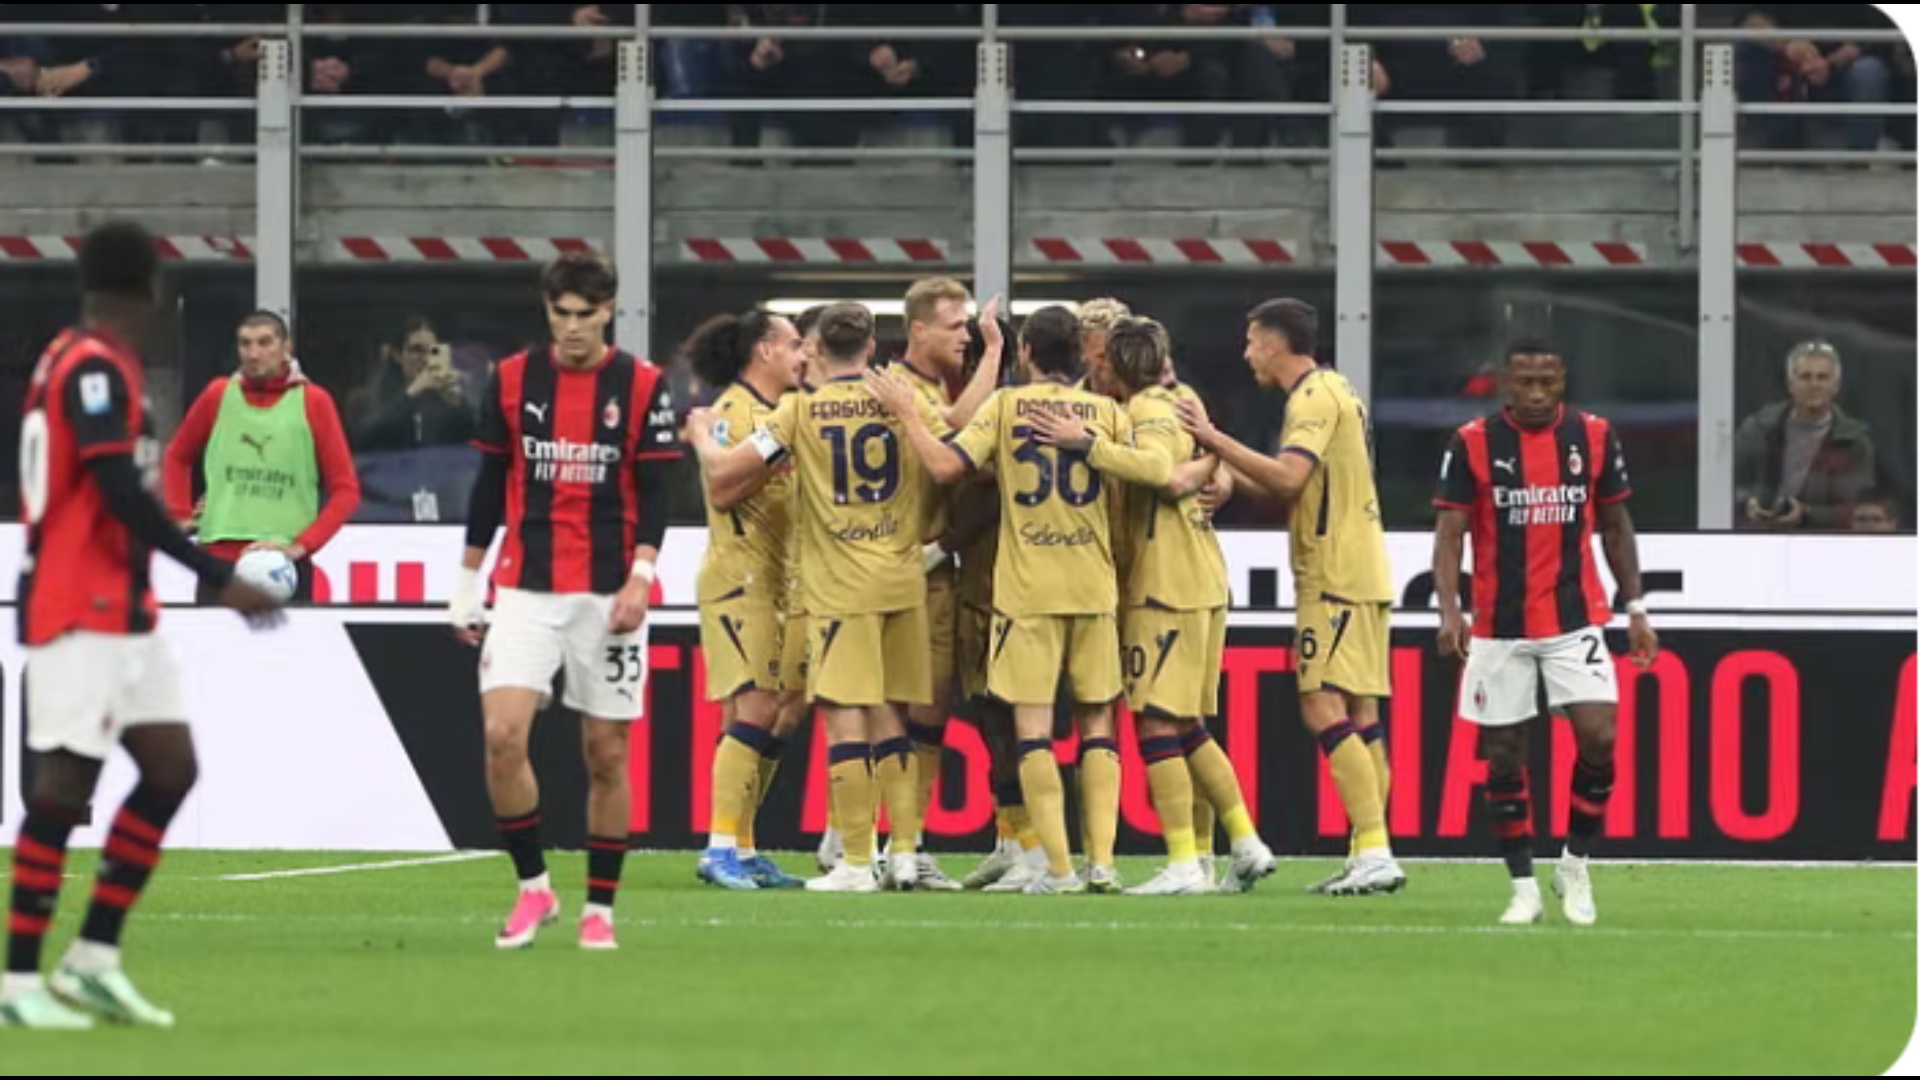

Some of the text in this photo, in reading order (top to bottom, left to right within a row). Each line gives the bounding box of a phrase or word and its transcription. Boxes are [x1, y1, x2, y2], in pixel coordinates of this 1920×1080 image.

[522, 435, 620, 460] Emirates
[820, 423, 899, 505] 19
[1493, 483, 1588, 508] Emirates
[605, 646, 641, 682] 33
[1582, 635, 1602, 665] 2
